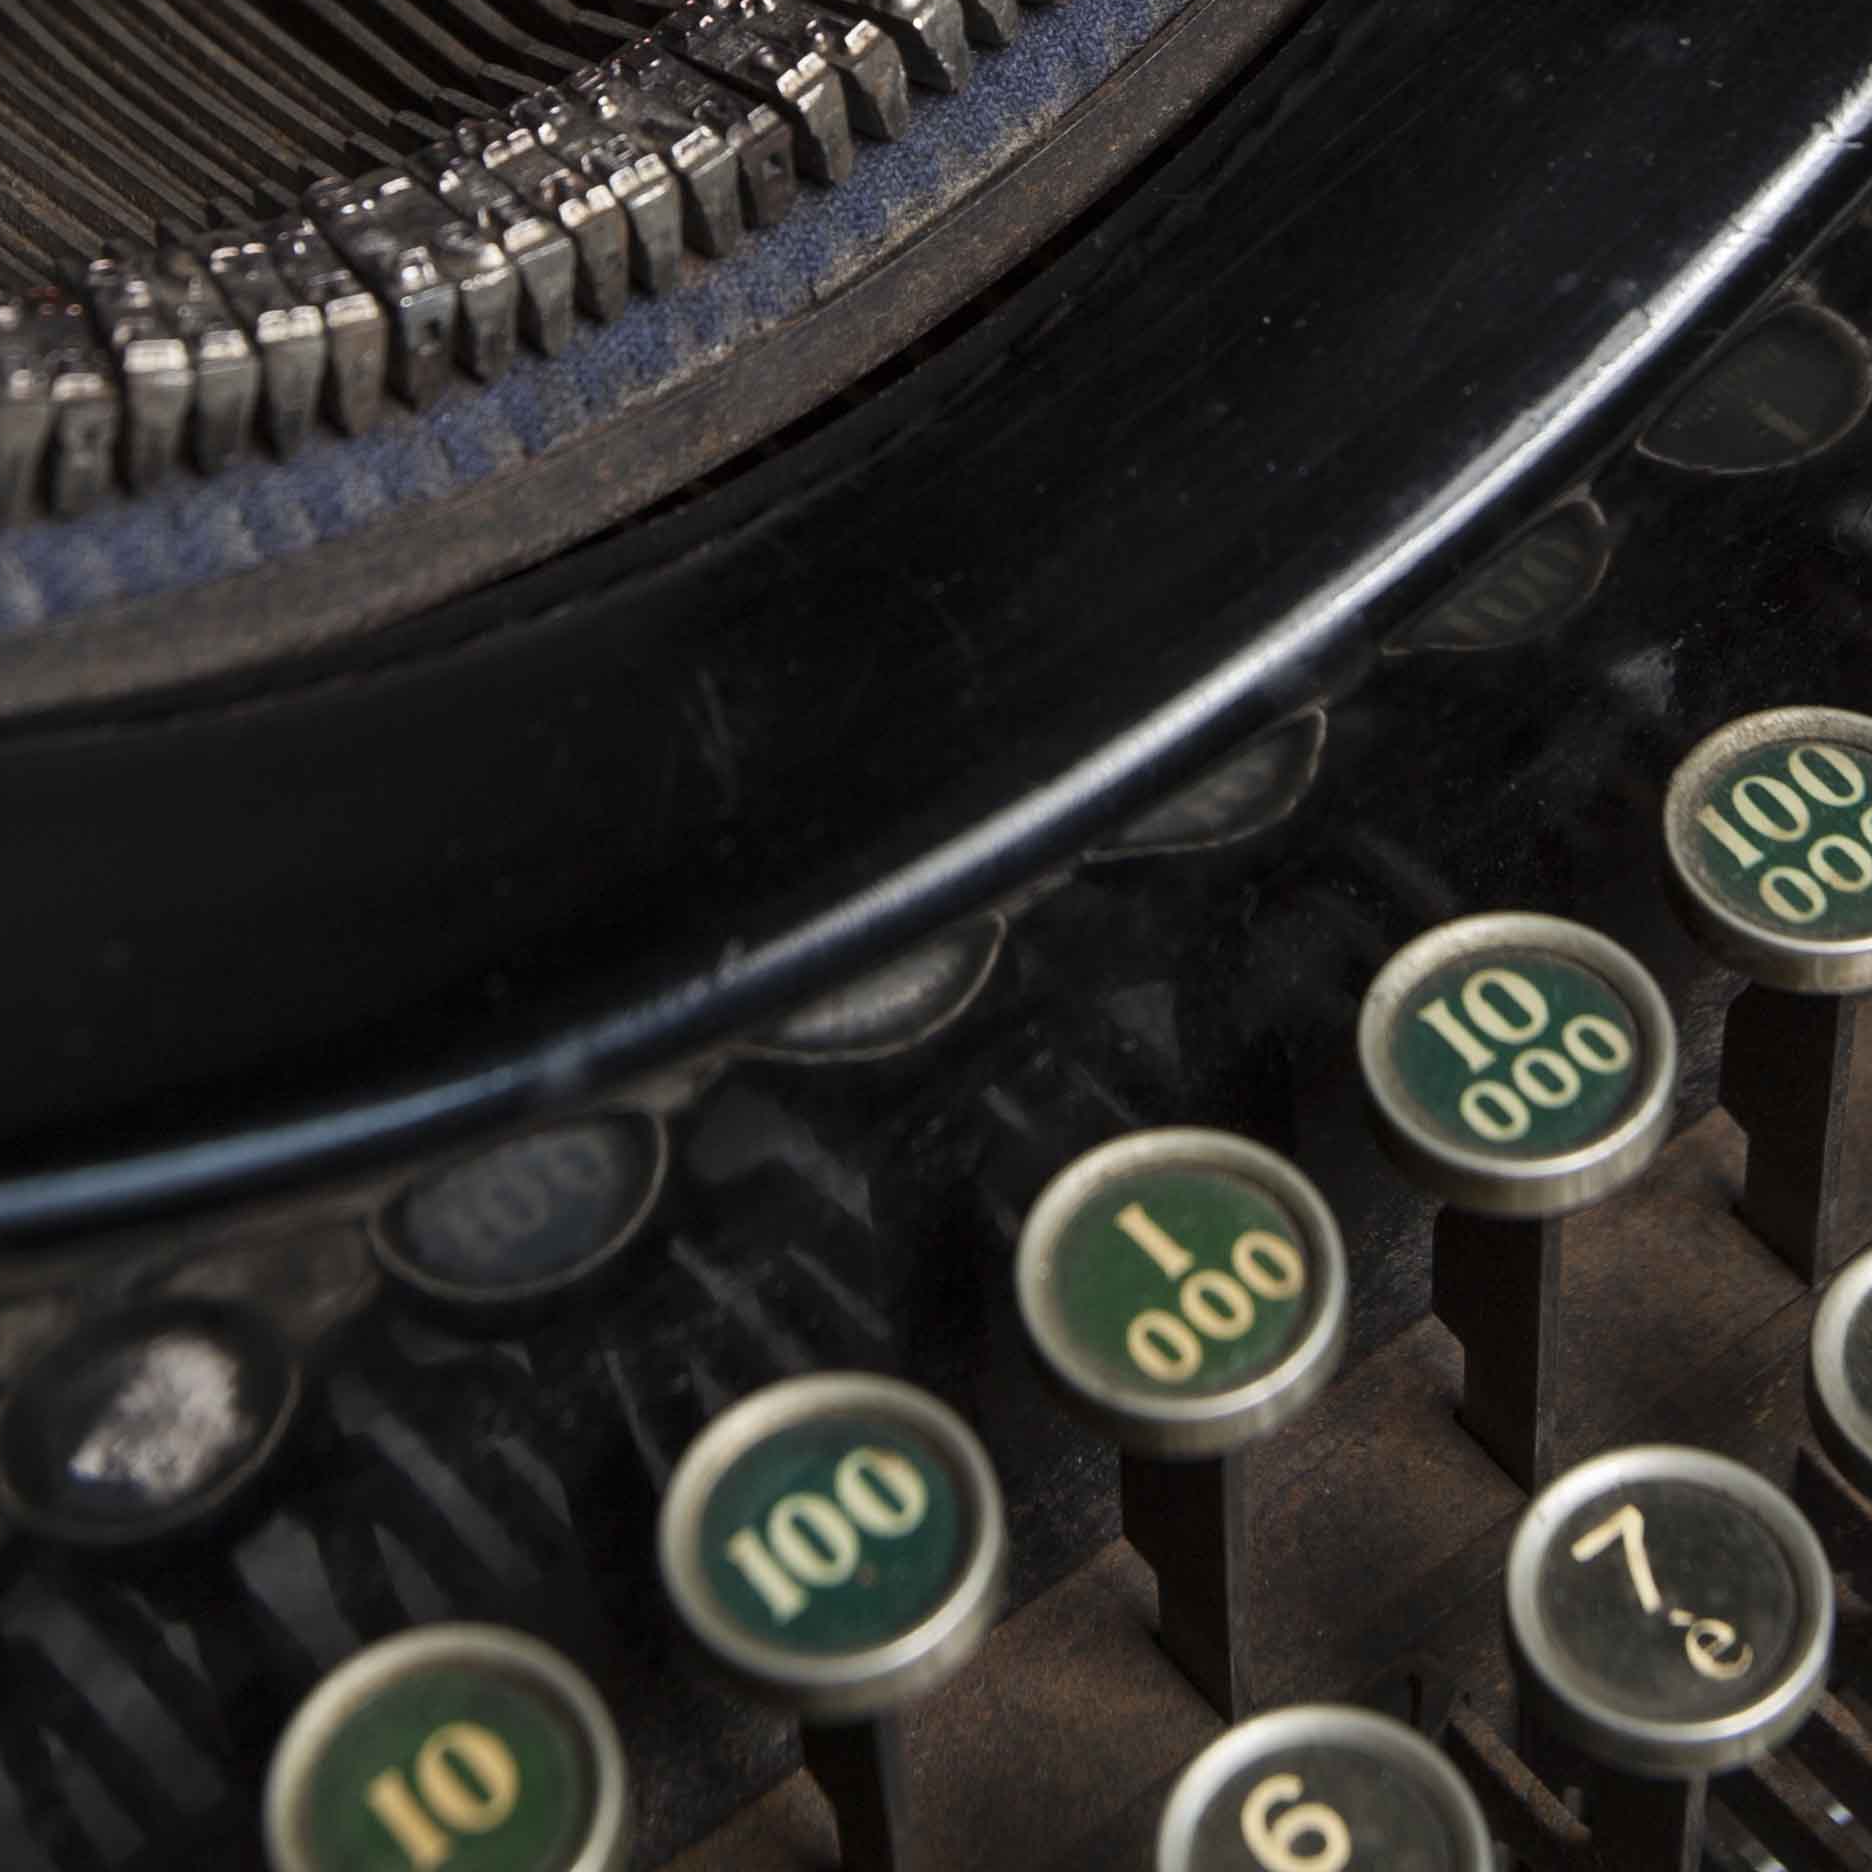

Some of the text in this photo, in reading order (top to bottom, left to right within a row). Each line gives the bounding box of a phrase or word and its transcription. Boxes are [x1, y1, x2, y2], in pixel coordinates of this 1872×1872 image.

[1697, 745, 1864, 867] 100
[1421, 970, 1548, 1071] 10
[1461, 1016, 1630, 1139] 000
[1119, 1206, 1190, 1276] 1
[1129, 1232, 1302, 1379] 000
[732, 1452, 925, 1615] 100
[1573, 1505, 1660, 1611] 7
[368, 1724, 519, 1870] 10
[1239, 1772, 1352, 1872] 6
